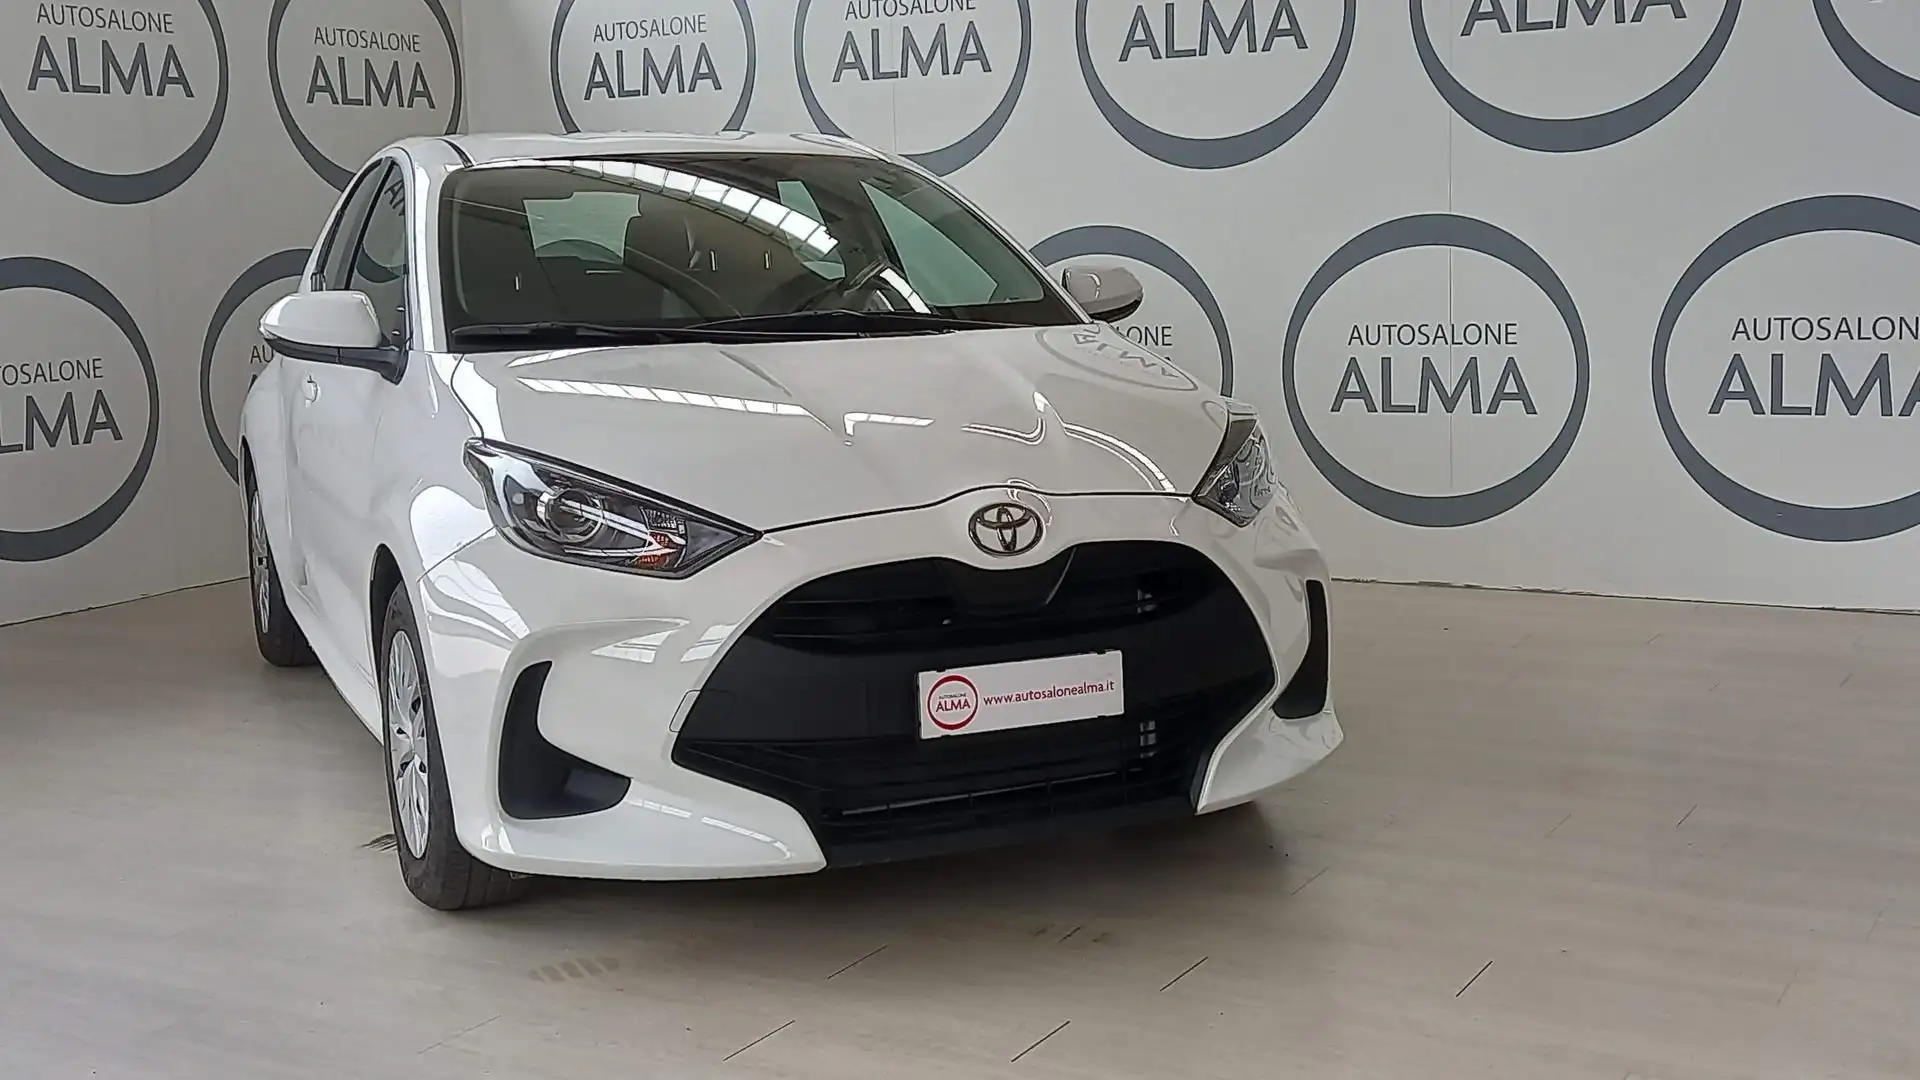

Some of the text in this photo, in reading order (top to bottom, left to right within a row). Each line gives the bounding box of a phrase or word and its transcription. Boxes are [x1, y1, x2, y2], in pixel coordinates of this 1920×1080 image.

[37, 3, 174, 34] AUTOSALONE
[593, 14, 708, 43] AUTOSALONE
[1118, 0, 1309, 62] ALMA
[314, 27, 421, 53] AUTOSALONE
[832, 20, 992, 82] ALMA
[27, 35, 195, 98] ALMA
[584, 42, 722, 101] ALMA
[306, 55, 436, 110] ALMA
[1348, 323, 1518, 346] AUTOSALONE
[0, 358, 104, 386] OSALONE
[1330, 356, 1538, 415] ALMA
[935, 698, 971, 713] ALMA
[983, 680, 1115, 706] www.autosalonealma.it
